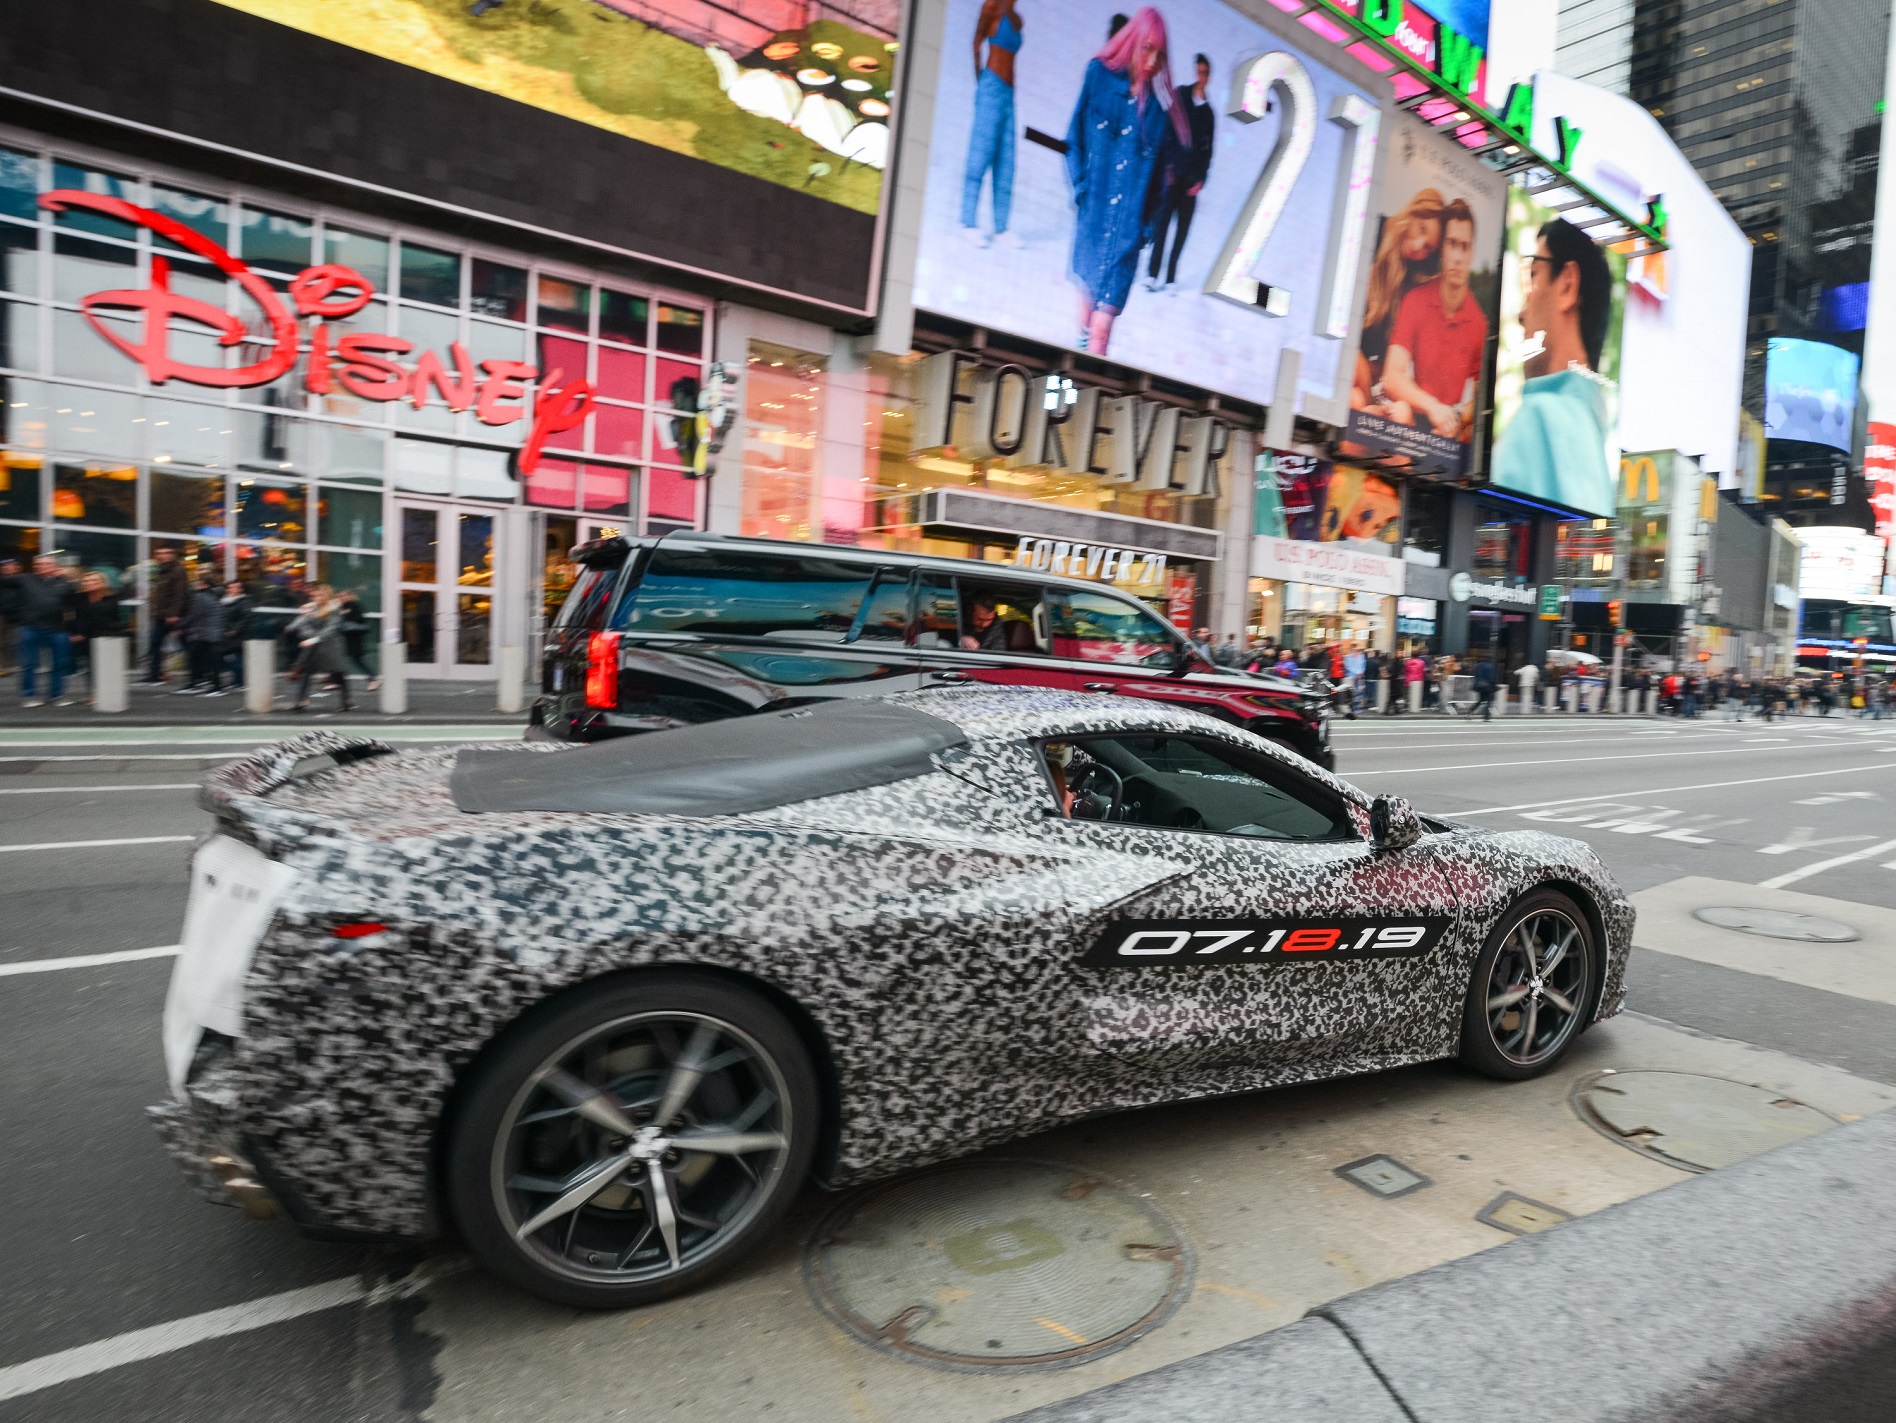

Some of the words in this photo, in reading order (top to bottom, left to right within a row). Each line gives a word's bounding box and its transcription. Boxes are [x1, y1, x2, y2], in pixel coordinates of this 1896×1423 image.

[1205, 50, 1382, 339] 21
[38, 188, 595, 476] Disney
[914, 350, 1228, 499] FOREVER
[1015, 536, 1135, 581] FOREVER
[1138, 553, 1167, 583] 21
[1117, 926, 1427, 956] 07.18.19
